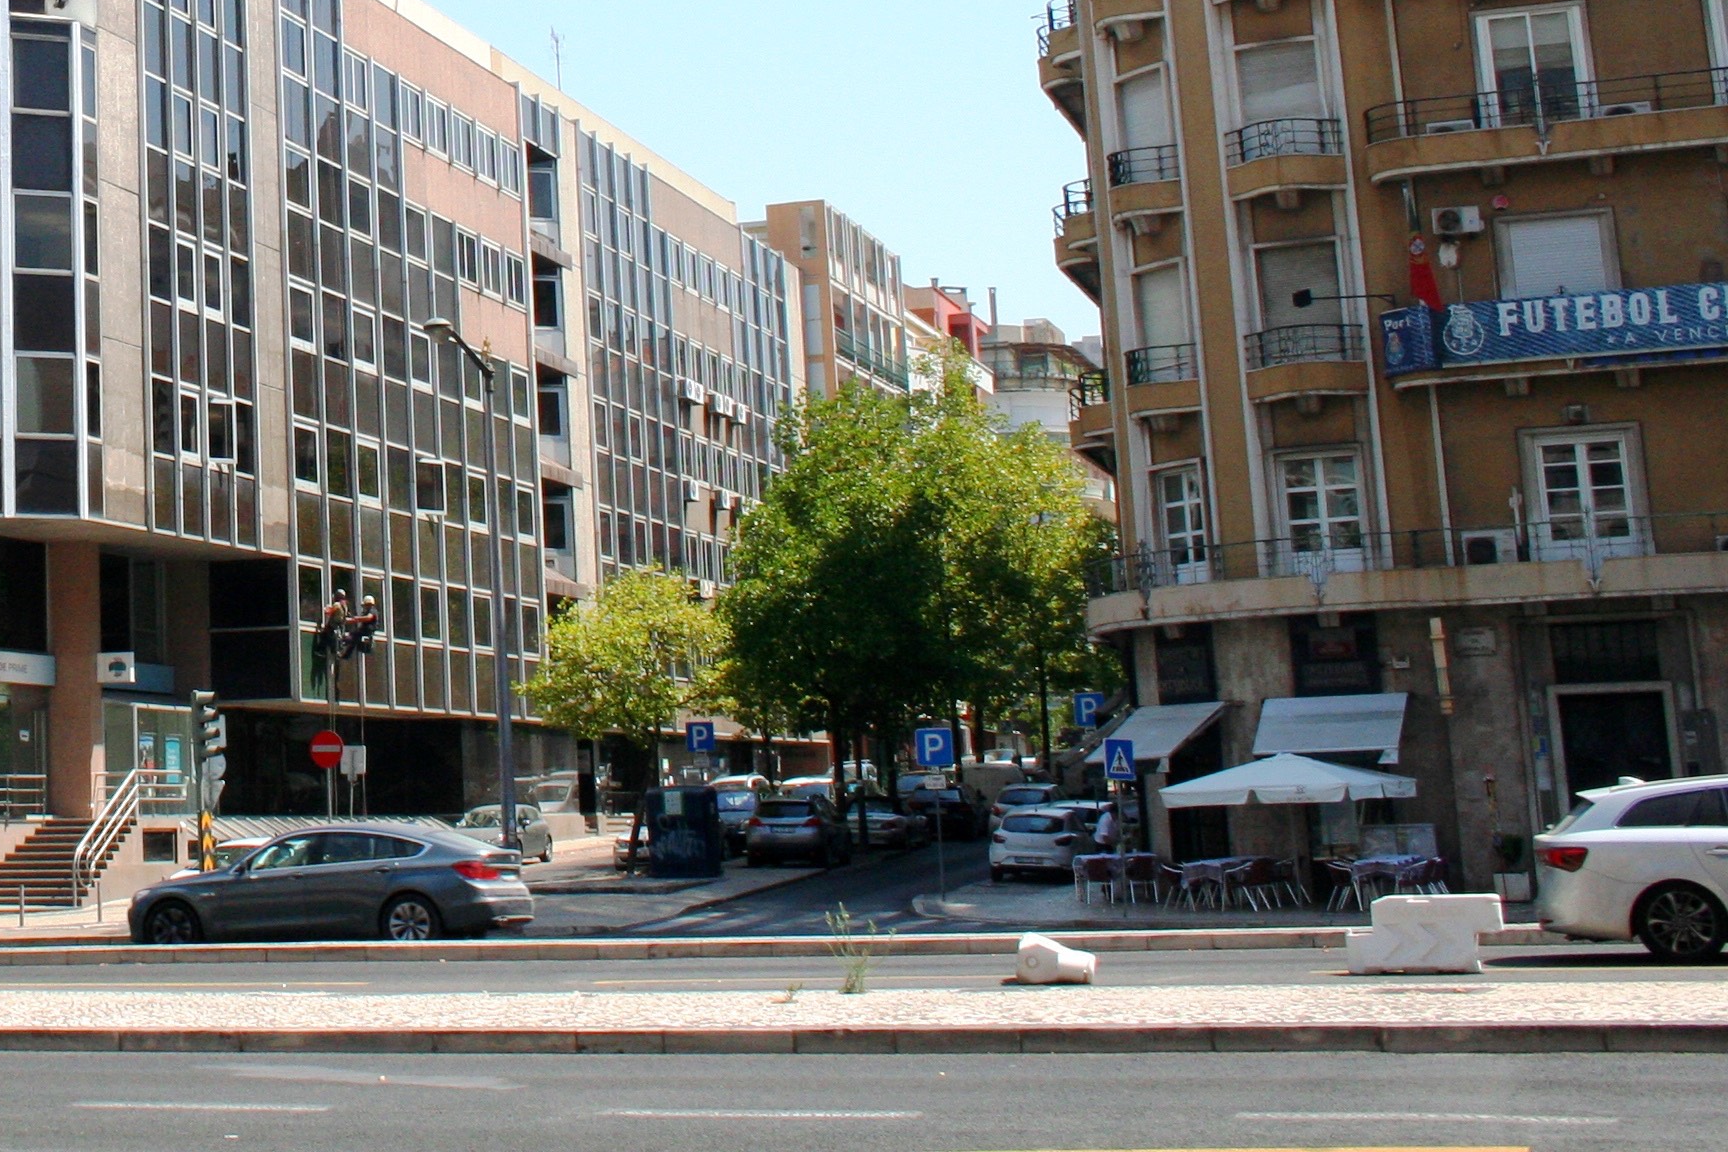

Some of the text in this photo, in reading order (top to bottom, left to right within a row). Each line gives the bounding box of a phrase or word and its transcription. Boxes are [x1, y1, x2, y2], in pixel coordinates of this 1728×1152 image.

[1497, 285, 1728, 337] FUTEBOL C
[1625, 325, 1728, 344] A VENC
[1082, 698, 1096, 723] P
[692, 726, 708, 748] P
[924, 733, 943, 762] P
